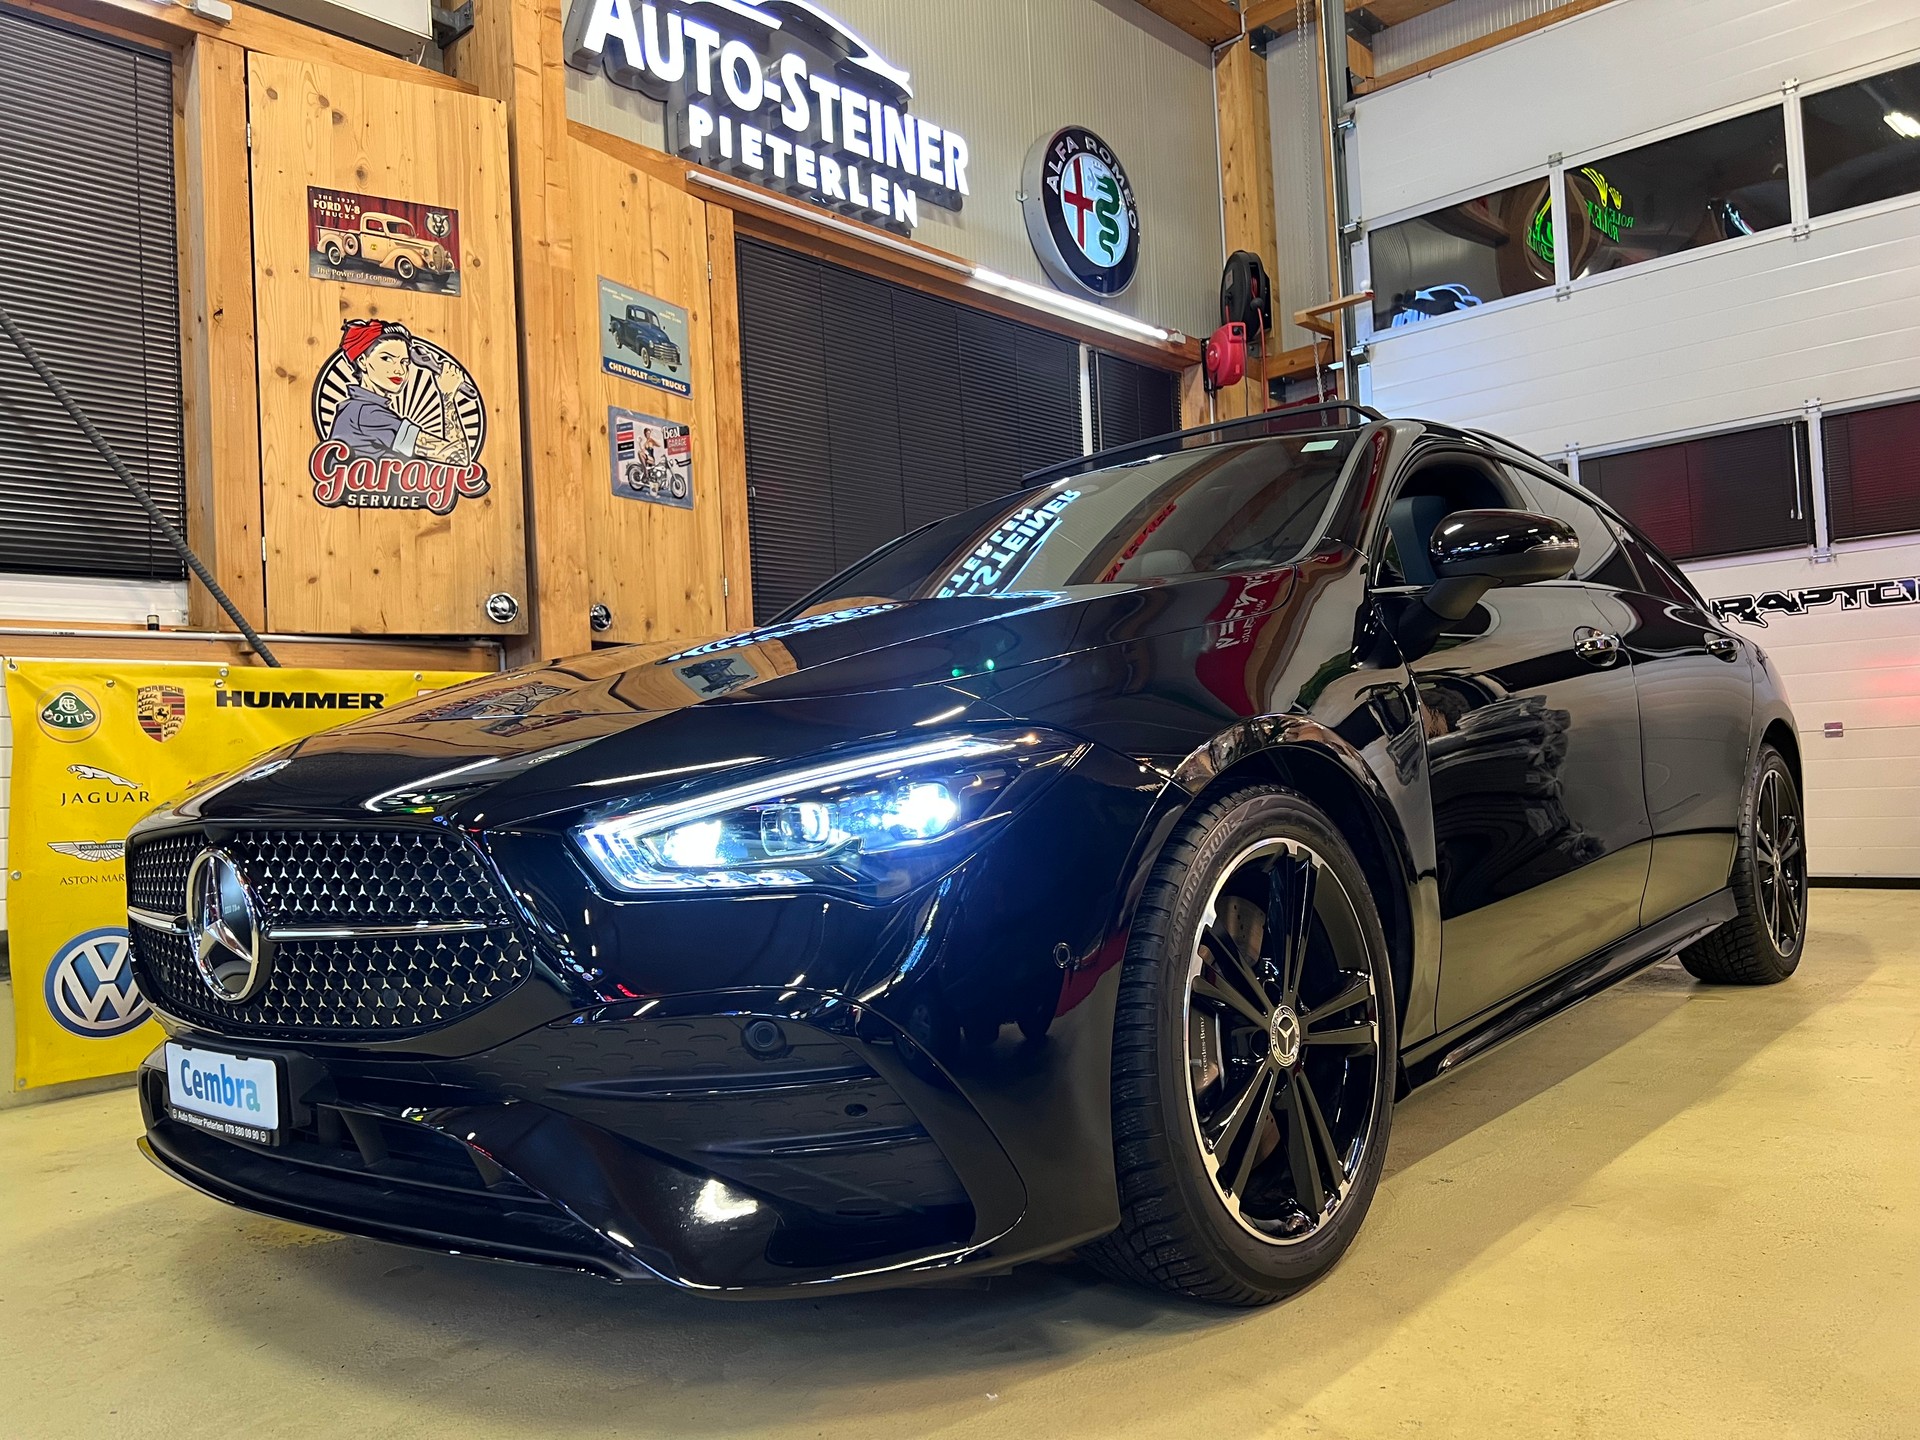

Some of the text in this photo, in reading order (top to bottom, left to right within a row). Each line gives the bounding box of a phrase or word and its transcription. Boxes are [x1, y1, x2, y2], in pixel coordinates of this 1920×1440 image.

[583, 0, 970, 196] AUTO-STEINER
[688, 103, 918, 229] PIETERLEN
[1046, 135, 1138, 230] ALFA ROMEO
[313, 199, 361, 215] FORD V-8
[320, 209, 356, 220] TRUCKS
[331, 269, 354, 278] Power
[365, 273, 398, 285] Economy
[608, 361, 687, 392] CHEVROLET TRUCKS
[310, 440, 486, 511] Garage
[347, 494, 421, 508] SERVICE
[1709, 575, 1920, 628] RAPTO
[137, 685, 184, 695] PORSCHE
[216, 690, 384, 709] HUMMER
[43, 709, 94, 725] OTUS
[61, 791, 150, 806] JAGUAR
[60, 874, 99, 886] ASTON
[181, 1058, 260, 1112] Cembra
[178, 1110, 188, 1122] Auto
[188, 1113, 203, 1126] Steiner
[203, 1118, 224, 1132] Pieterlen
[225, 1123, 235, 1135] 079
